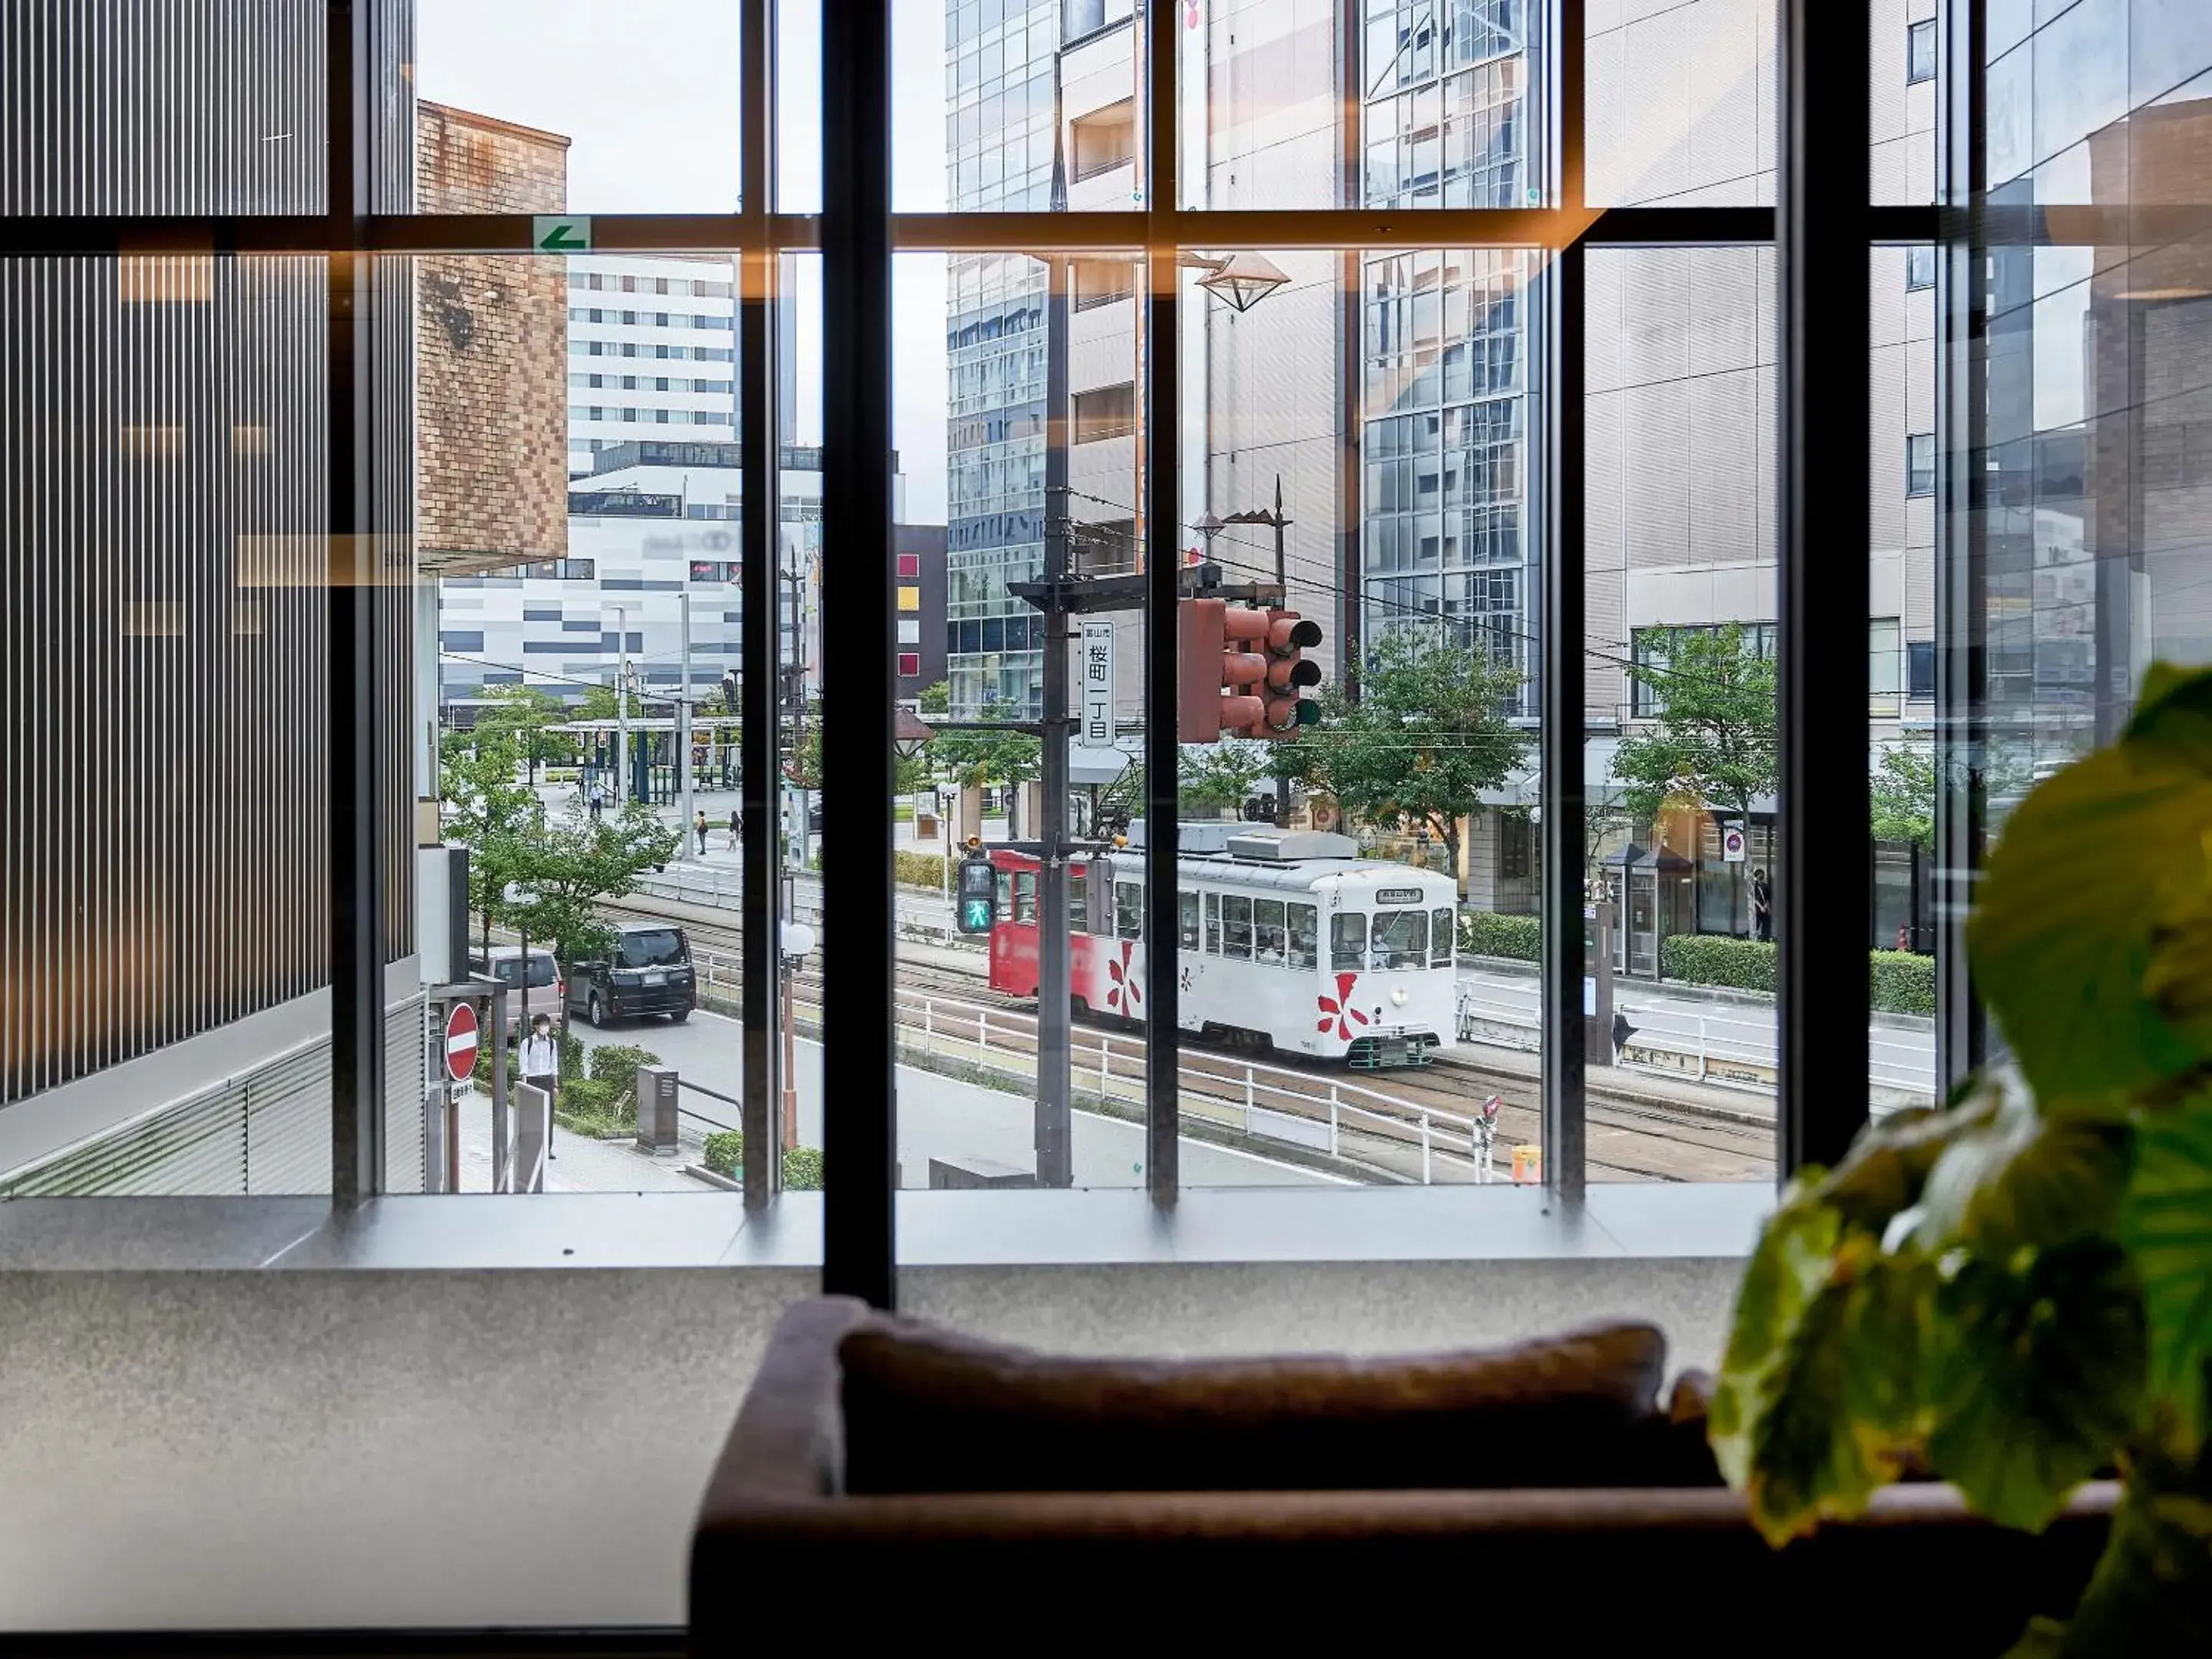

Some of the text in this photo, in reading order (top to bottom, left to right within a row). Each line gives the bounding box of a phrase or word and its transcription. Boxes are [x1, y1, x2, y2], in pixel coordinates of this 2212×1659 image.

[1089, 644, 1108, 738] 桜町一丁目
